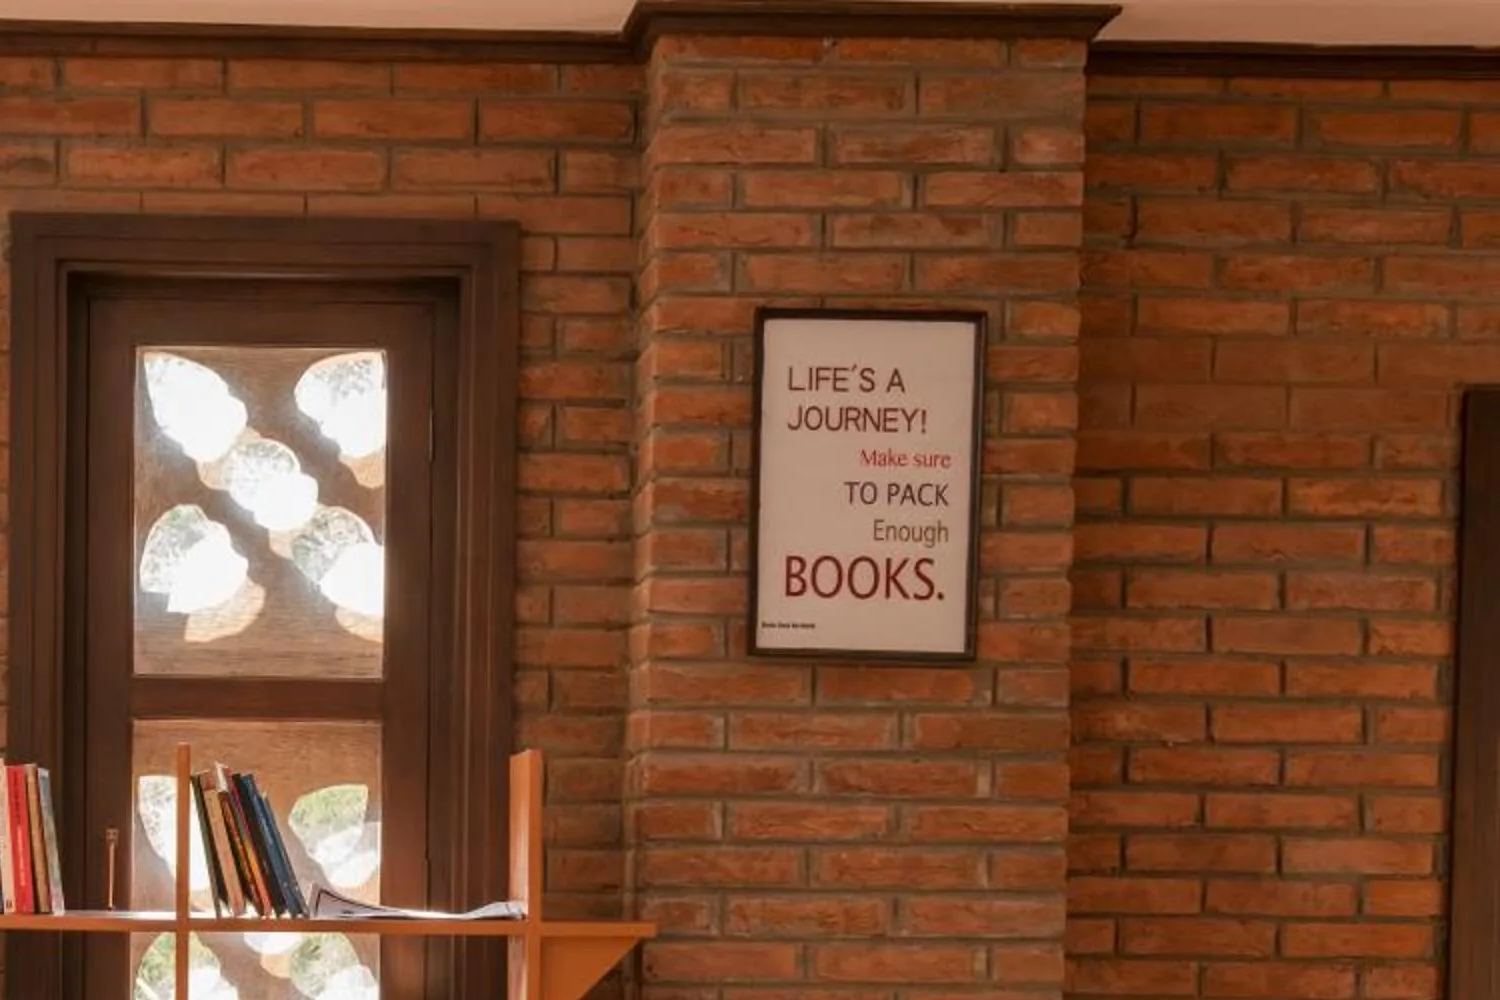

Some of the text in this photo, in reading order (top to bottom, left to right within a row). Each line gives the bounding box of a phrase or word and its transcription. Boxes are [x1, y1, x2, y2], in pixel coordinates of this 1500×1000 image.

[788, 363, 906, 393] LIFE'S A
[787, 405, 927, 433] JOURNEY!
[860, 448, 952, 468] Make sure
[844, 481, 949, 506] TO PACK
[873, 519, 949, 548] Enough
[785, 555, 944, 600] BOOKS.
